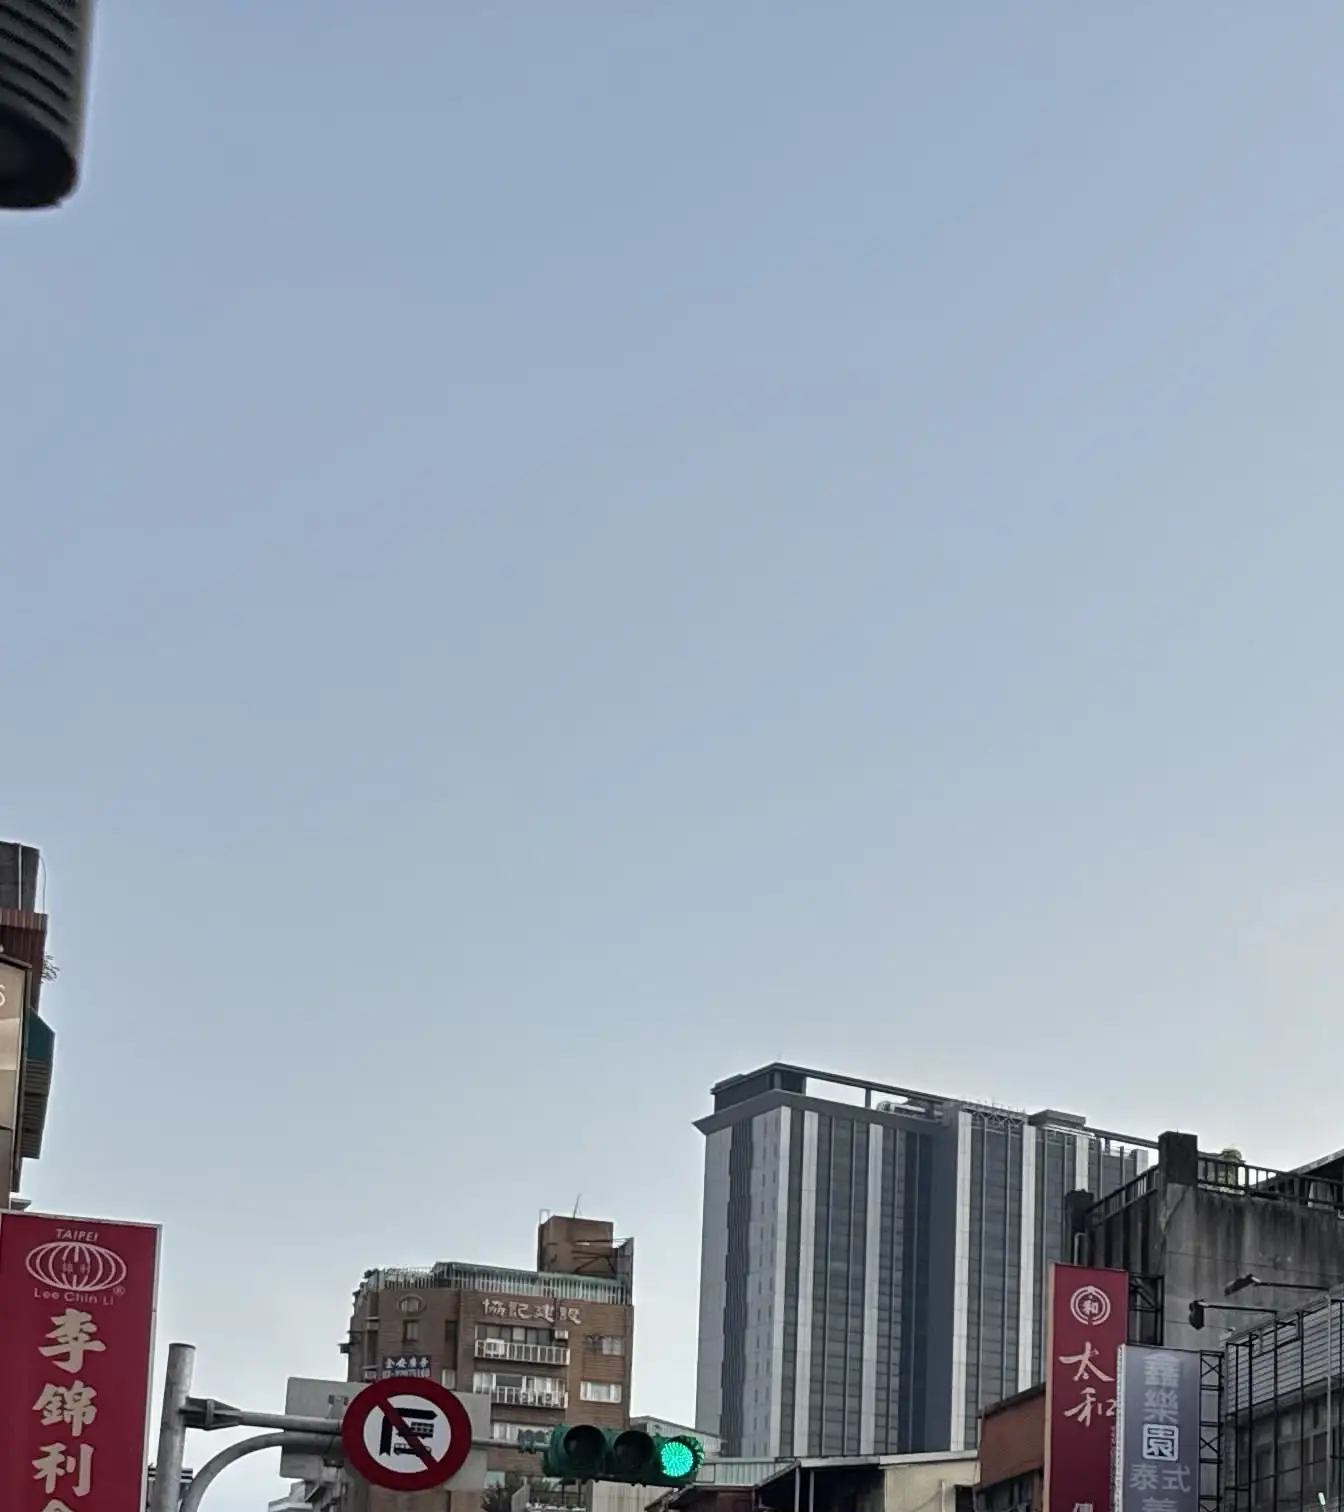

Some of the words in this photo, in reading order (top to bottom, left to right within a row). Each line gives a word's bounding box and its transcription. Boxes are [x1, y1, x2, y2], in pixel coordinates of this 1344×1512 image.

[55, 1228, 101, 1242] TAIPEI
[34, 1287, 60, 1300] Lee
[63, 1291, 98, 1305] Chin
[1058, 1341, 1117, 1428] 太和
[1130, 1463, 1192, 1494] 泰式
